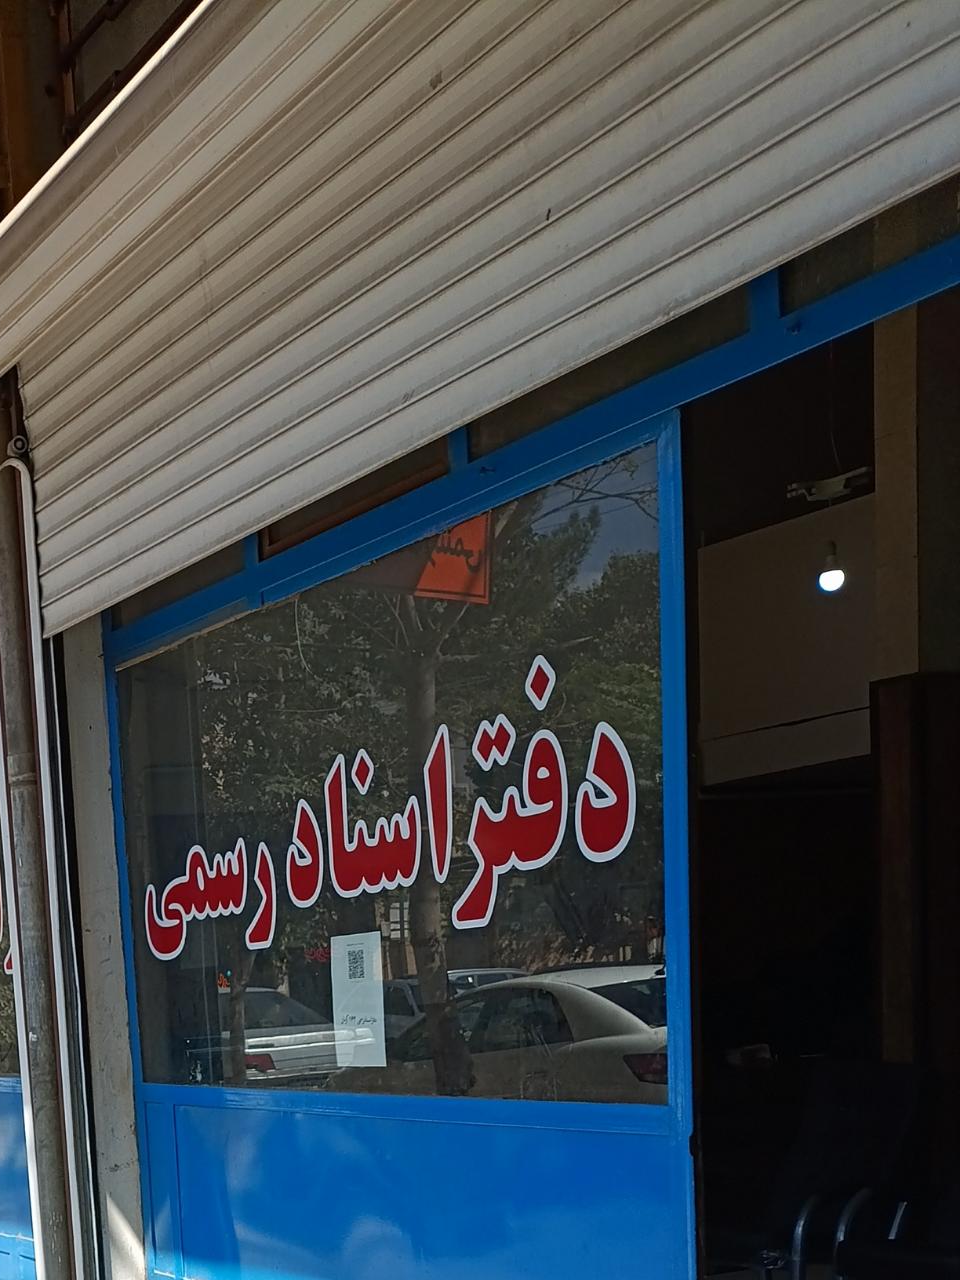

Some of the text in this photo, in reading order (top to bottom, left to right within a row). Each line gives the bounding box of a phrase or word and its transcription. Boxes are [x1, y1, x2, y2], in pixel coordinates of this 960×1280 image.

[145, 655, 637, 960] دفتر اسناد رسمی
